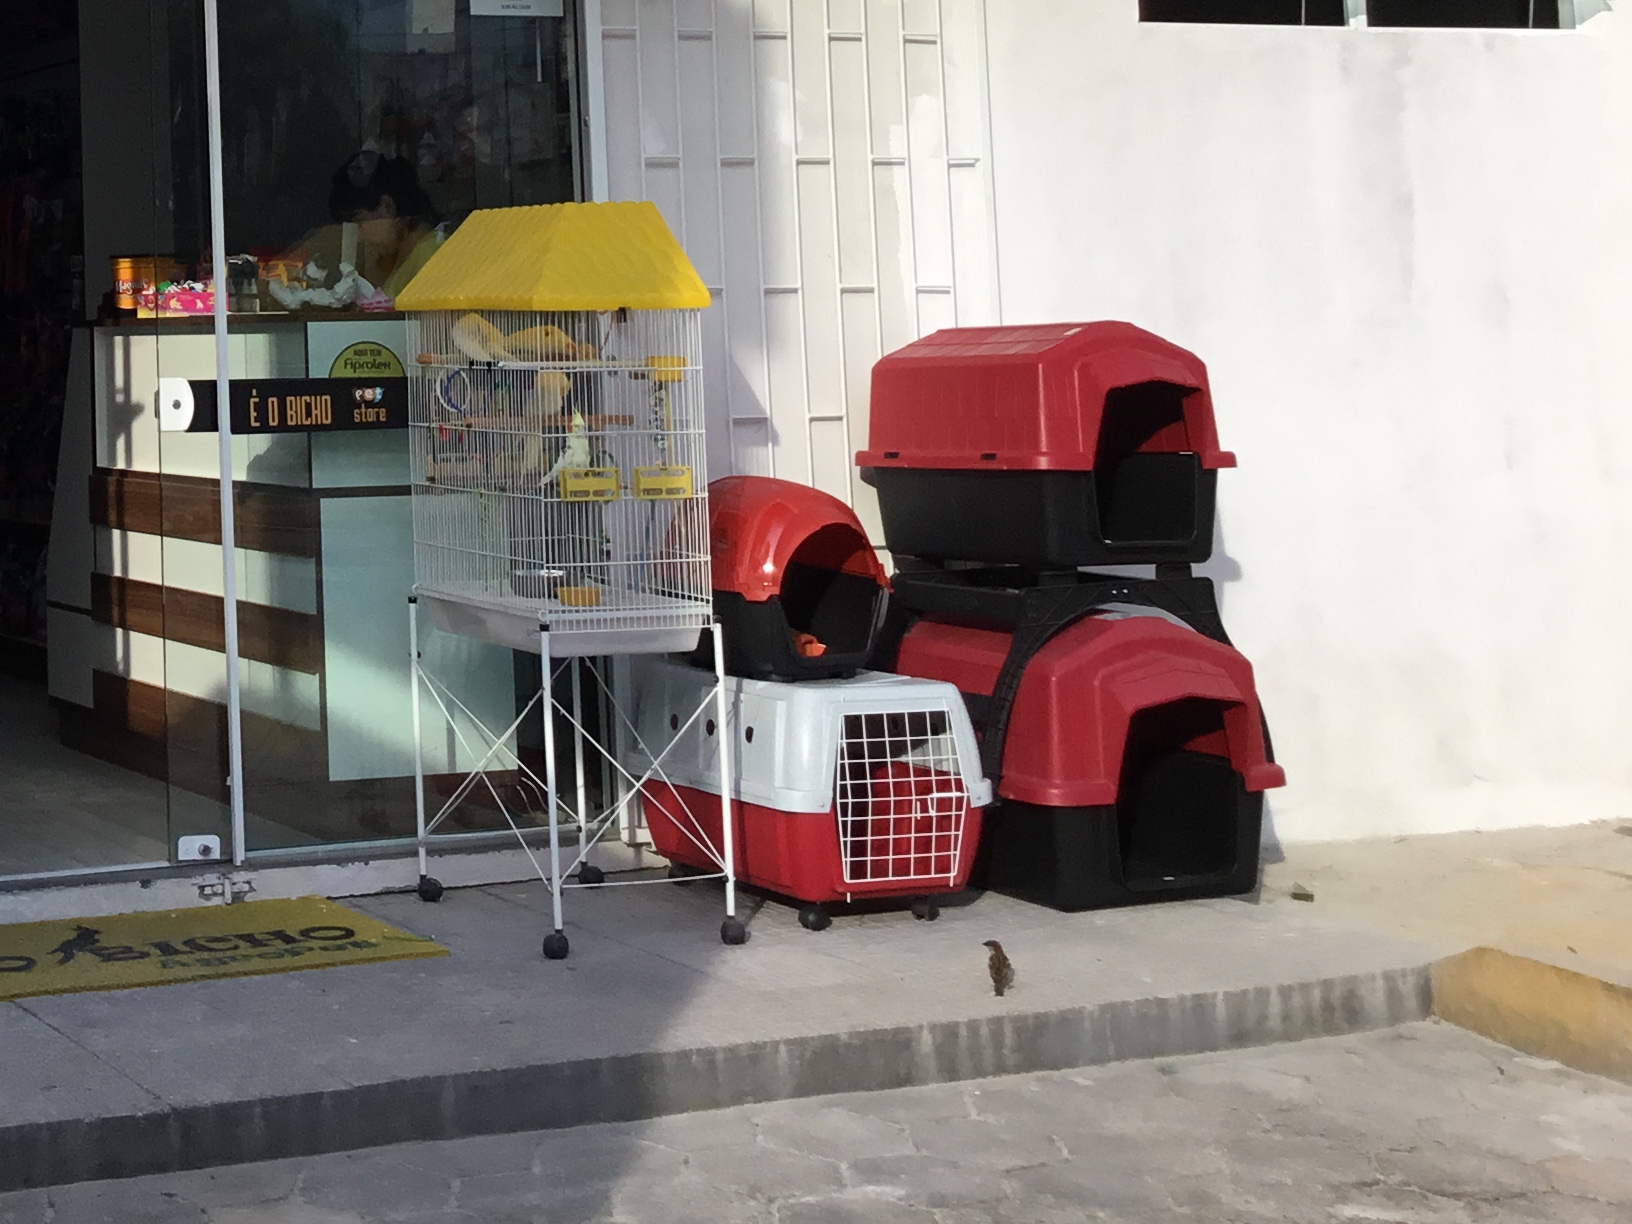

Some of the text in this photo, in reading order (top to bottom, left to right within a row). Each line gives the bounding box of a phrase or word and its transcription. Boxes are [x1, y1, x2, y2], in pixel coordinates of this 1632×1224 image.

[249, 388, 332, 427] É O BICHO
[353, 403, 387, 423] store
[84, 925, 357, 964] BICHO
